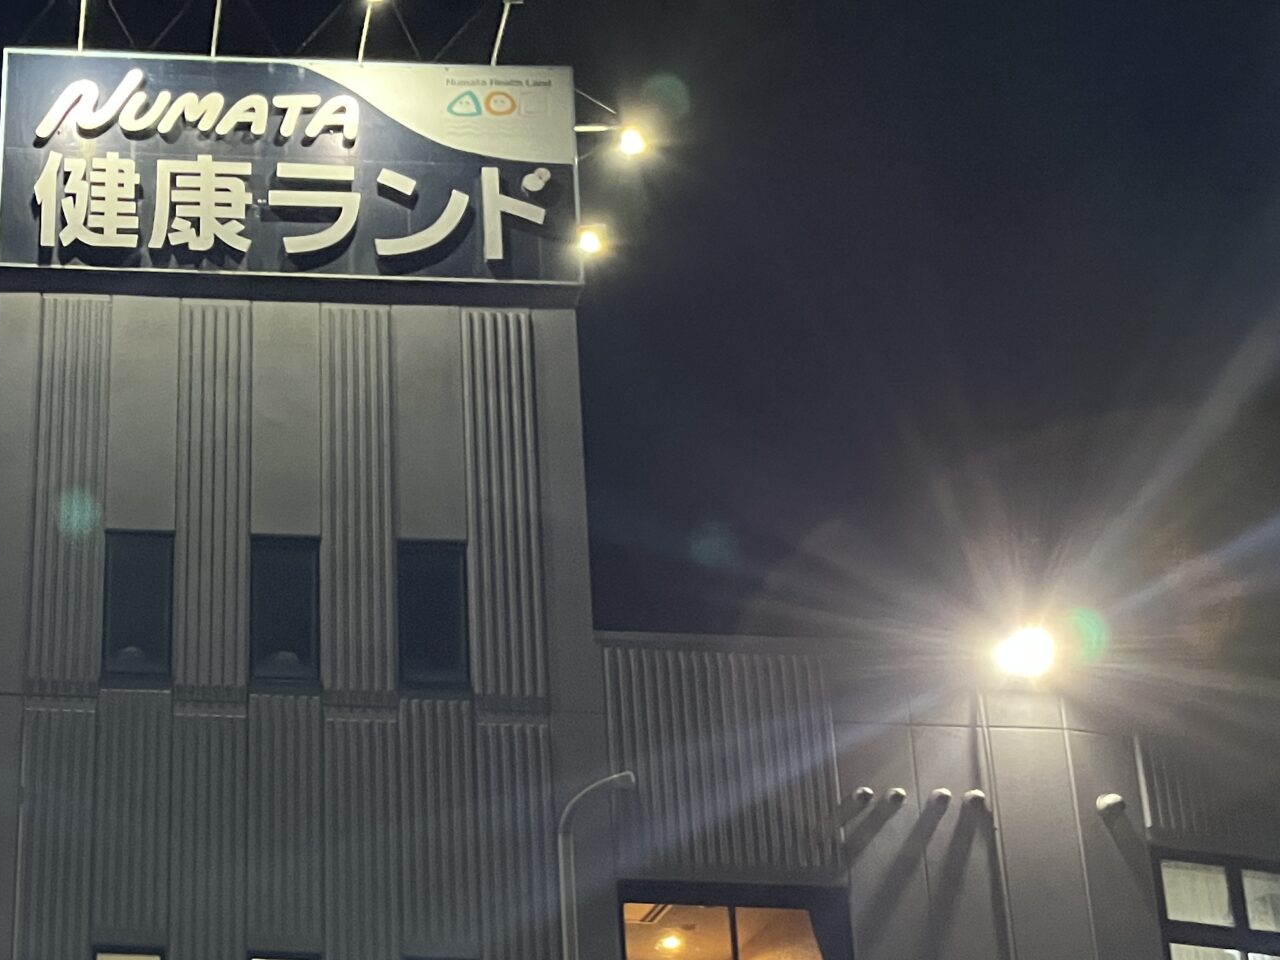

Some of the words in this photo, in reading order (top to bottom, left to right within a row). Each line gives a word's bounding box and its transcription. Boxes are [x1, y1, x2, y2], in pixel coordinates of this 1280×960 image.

[35, 68, 360, 143] NUMATA
[34, 151, 552, 262] 健康ランド
